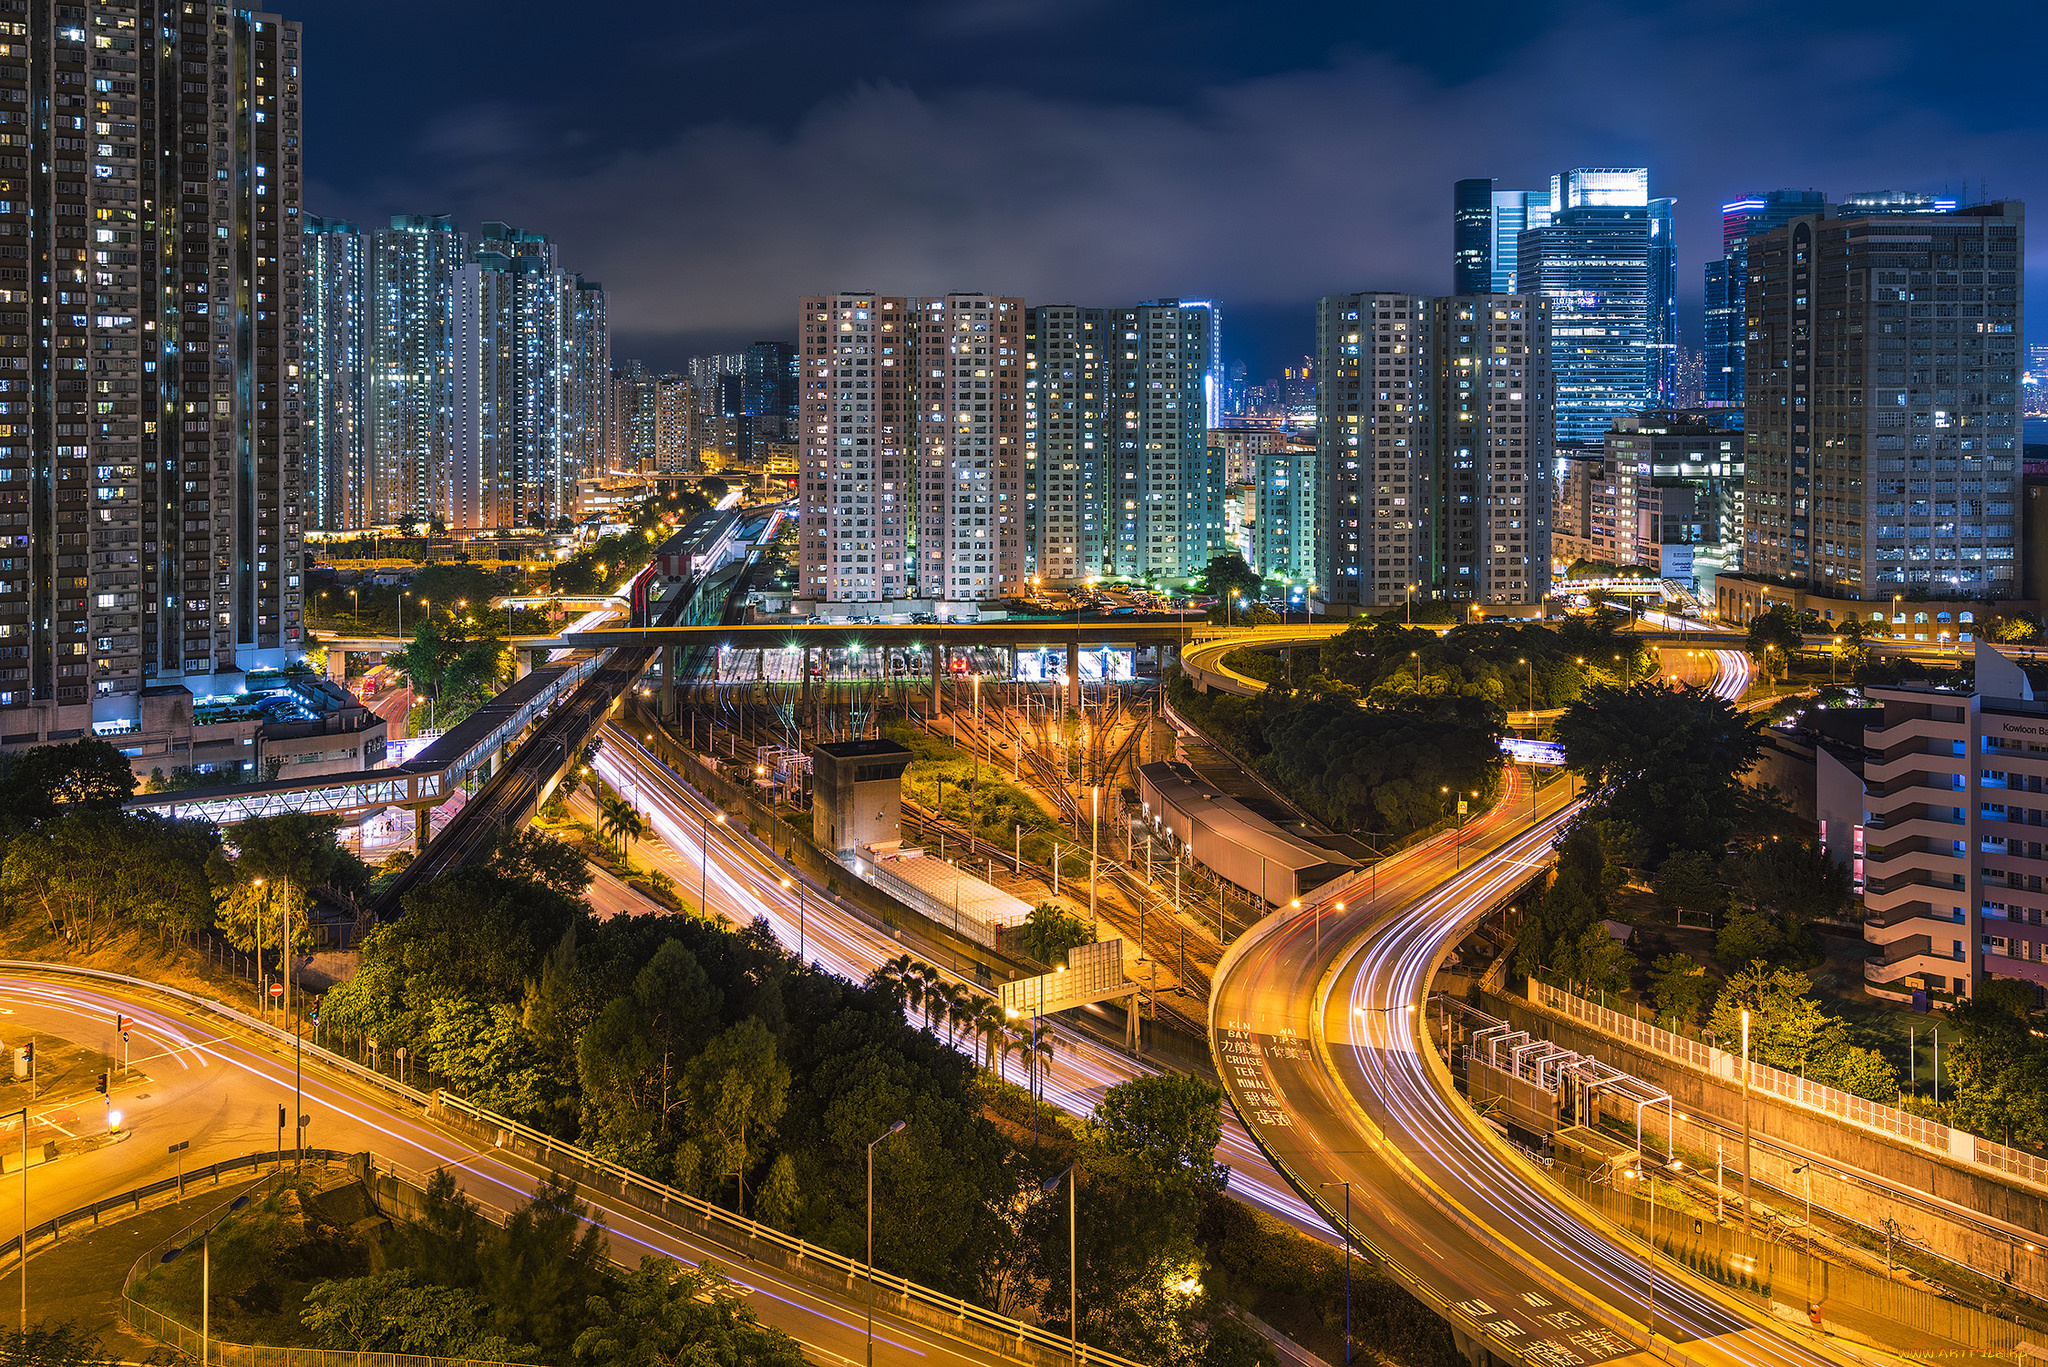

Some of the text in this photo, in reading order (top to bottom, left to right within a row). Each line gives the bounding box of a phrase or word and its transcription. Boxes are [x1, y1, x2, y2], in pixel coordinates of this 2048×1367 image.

[2003, 723, 2036, 734] Kowloon
[1229, 1021, 1250, 1030] KLN
[1227, 1030, 1249, 1040] BAY
[1225, 1055, 1263, 1066] CRUISE
[1234, 1066, 1262, 1077] TER-
[1236, 1078, 1270, 1089] MINAL
[1519, 1291, 1553, 1308] WAI
[1456, 1298, 1498, 1317] KLN
[1486, 1319, 1527, 1338] BAY
